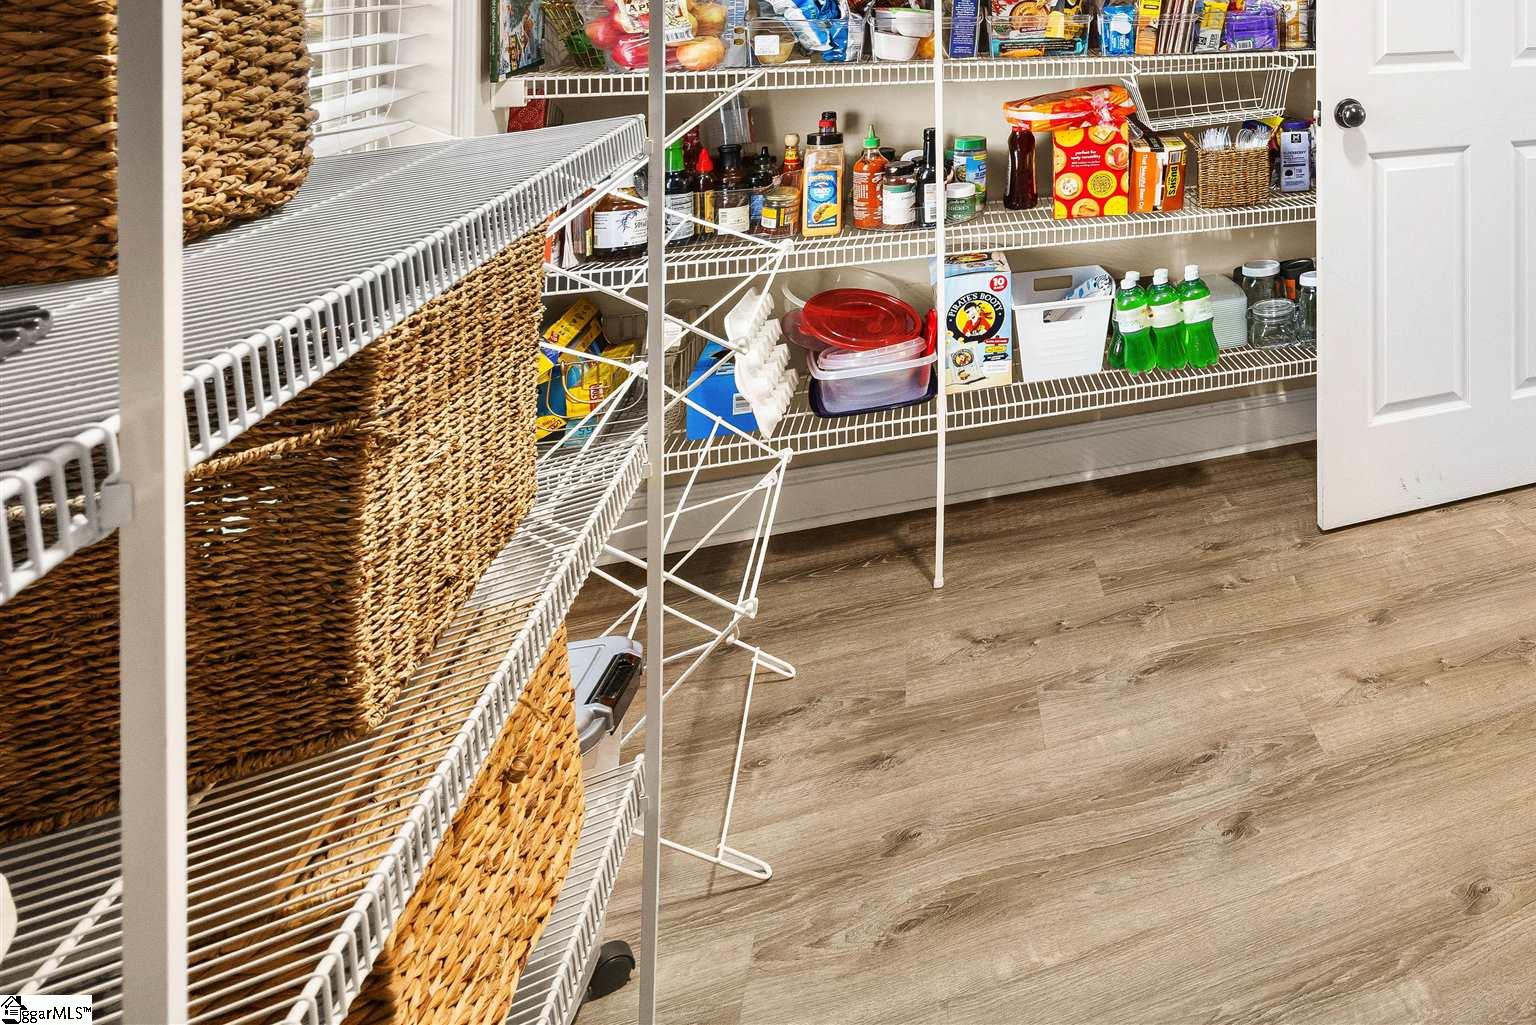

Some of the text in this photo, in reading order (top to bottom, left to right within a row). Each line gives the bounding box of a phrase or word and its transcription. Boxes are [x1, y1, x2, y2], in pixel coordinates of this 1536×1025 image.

[1169, 166, 1178, 196] BUSH'S
[993, 278, 1004, 286] 10
[949, 292, 1003, 316] PIRATE'S BOOTY
